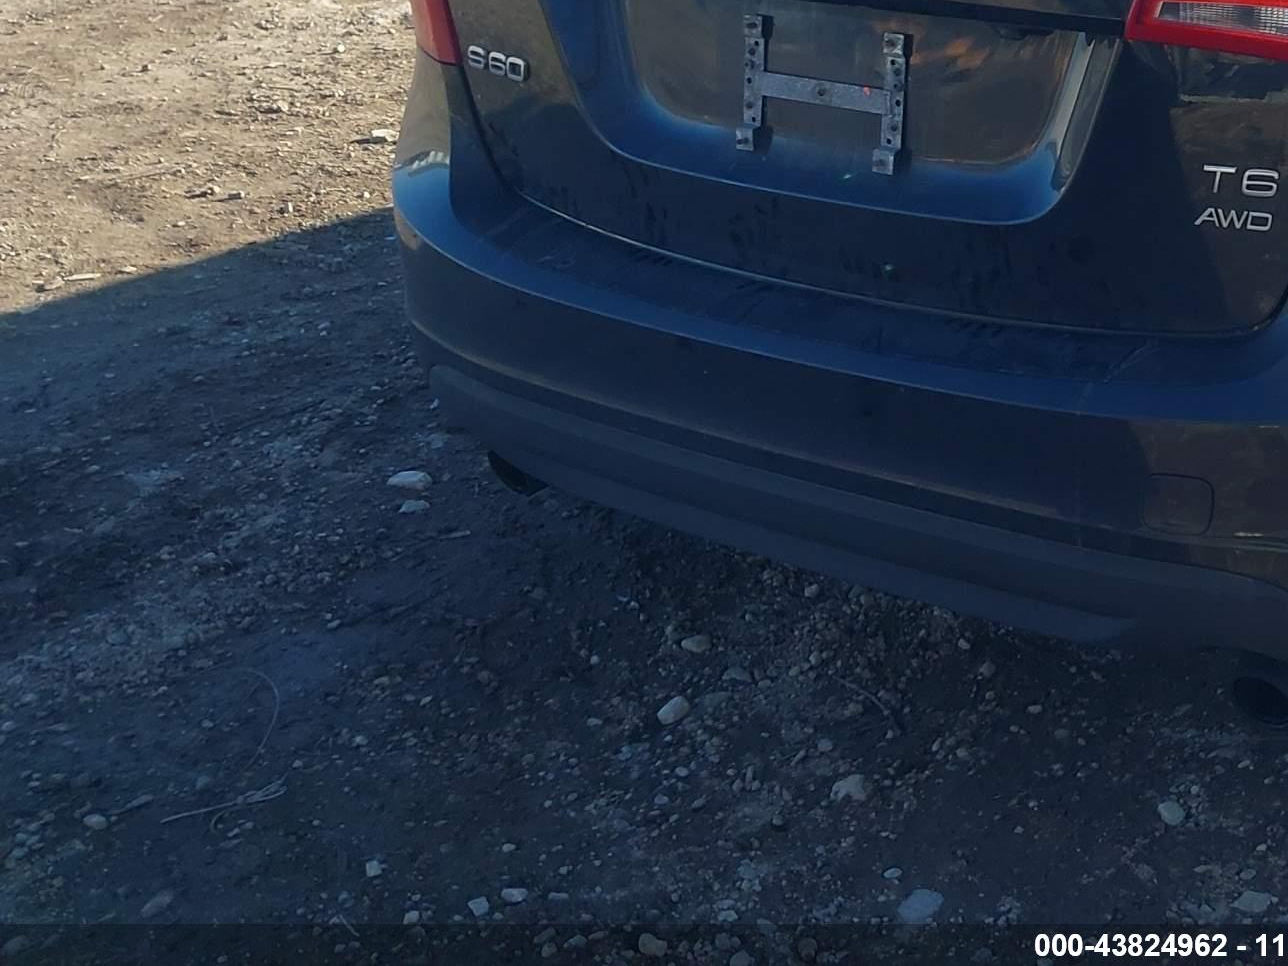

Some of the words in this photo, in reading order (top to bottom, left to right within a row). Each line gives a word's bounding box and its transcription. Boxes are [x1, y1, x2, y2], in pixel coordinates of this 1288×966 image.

[467, 44, 525, 83] S60
[1203, 165, 1280, 197] T6
[1194, 208, 1273, 232] AWD
